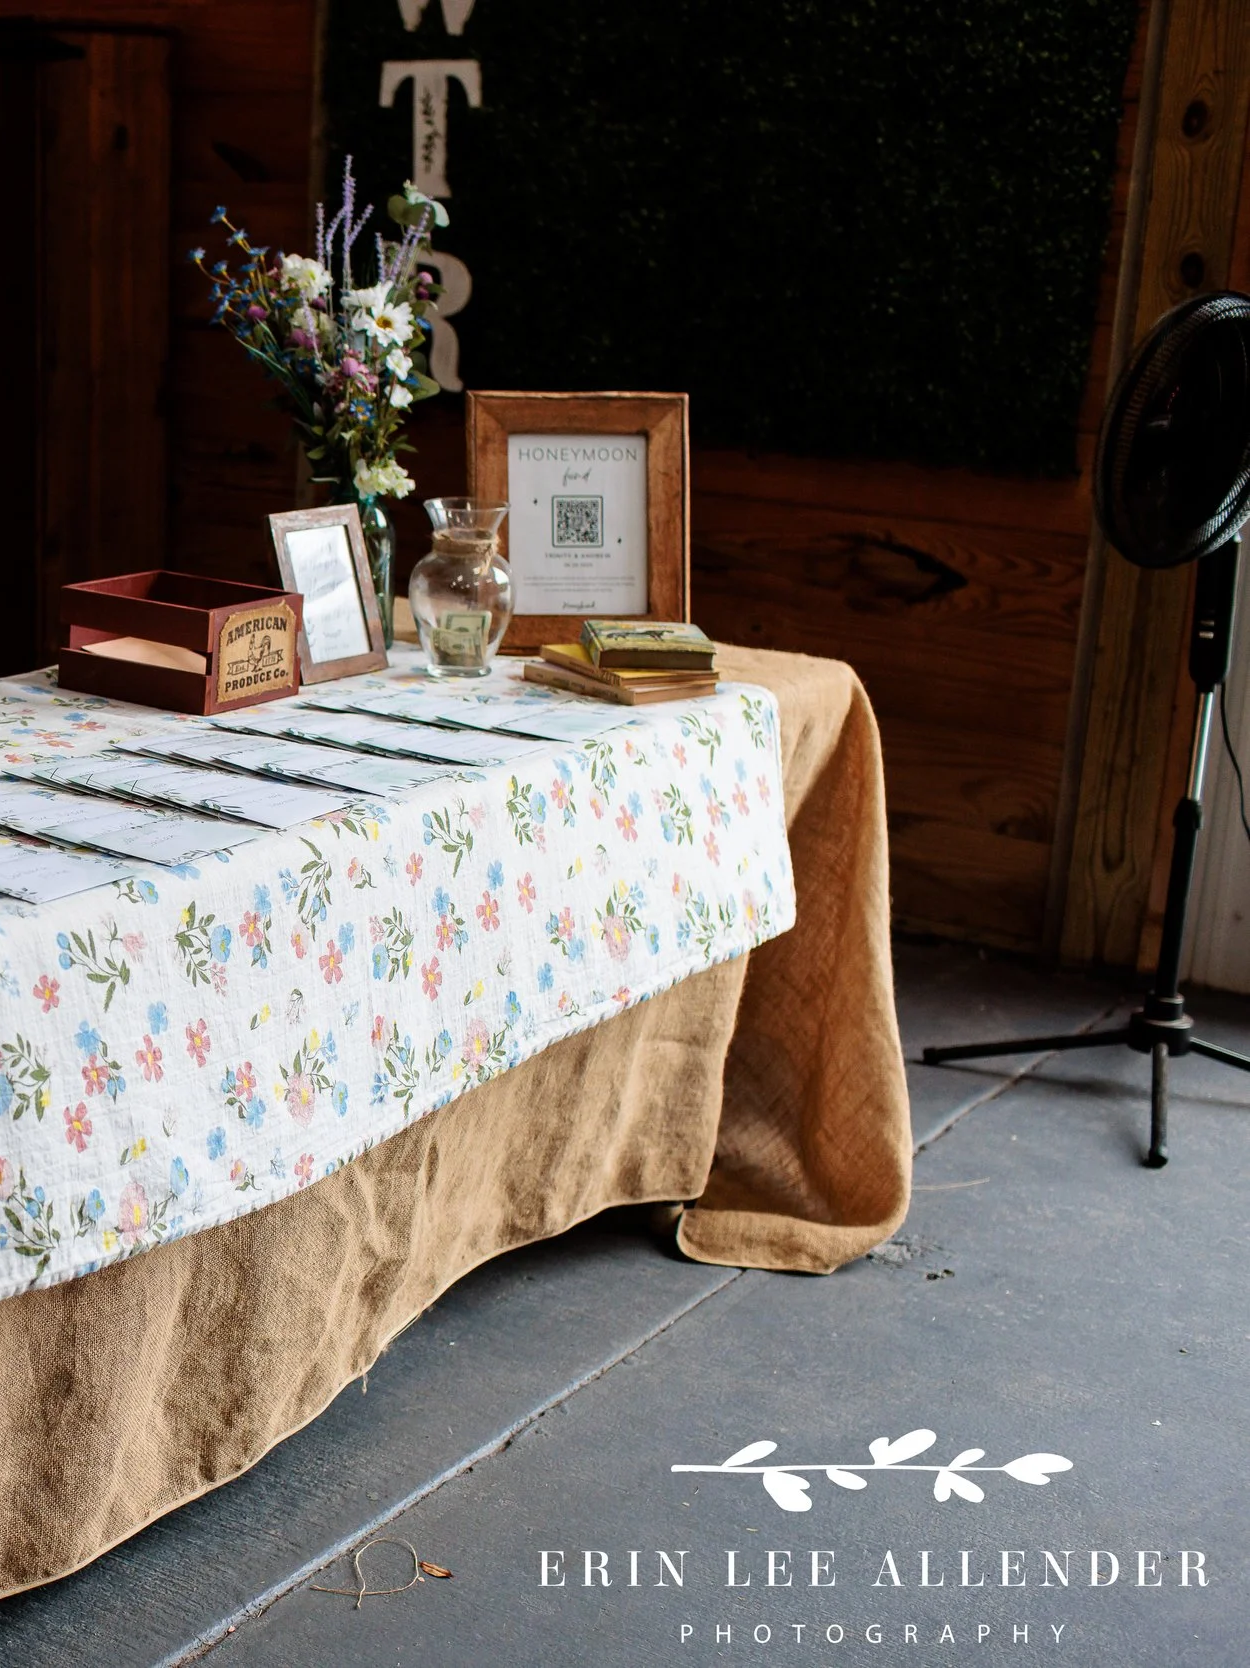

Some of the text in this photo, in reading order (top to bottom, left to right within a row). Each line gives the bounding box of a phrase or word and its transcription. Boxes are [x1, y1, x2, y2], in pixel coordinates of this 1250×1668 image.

[518, 447, 638, 462] HONEYMOON
[226, 616, 287, 648] AMERICAN
[225, 668, 289, 693] PRODUCE Co.
